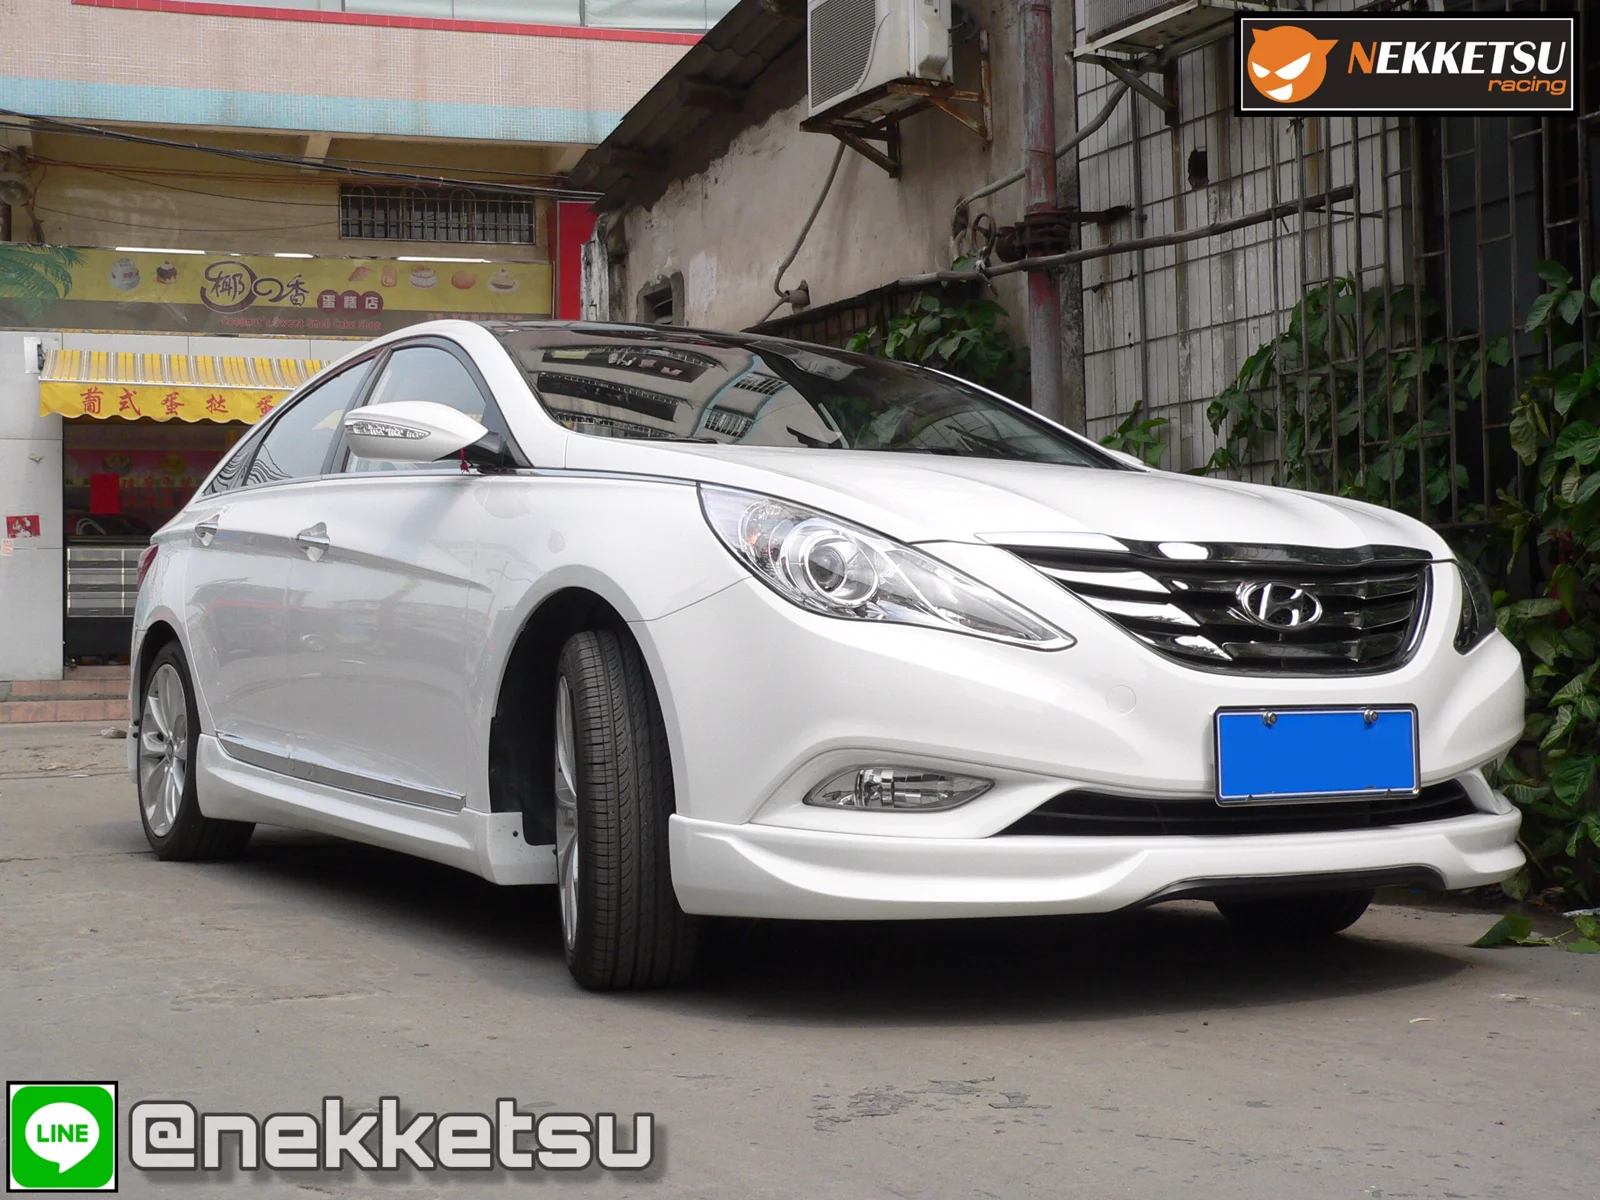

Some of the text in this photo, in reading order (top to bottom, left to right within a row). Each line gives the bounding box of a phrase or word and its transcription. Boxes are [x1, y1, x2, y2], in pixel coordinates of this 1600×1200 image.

[322, 294, 379, 310] 蛋糕店
[273, 317, 304, 328] Sweet
[333, 318, 356, 330] Cake
[358, 319, 382, 331] Shop
